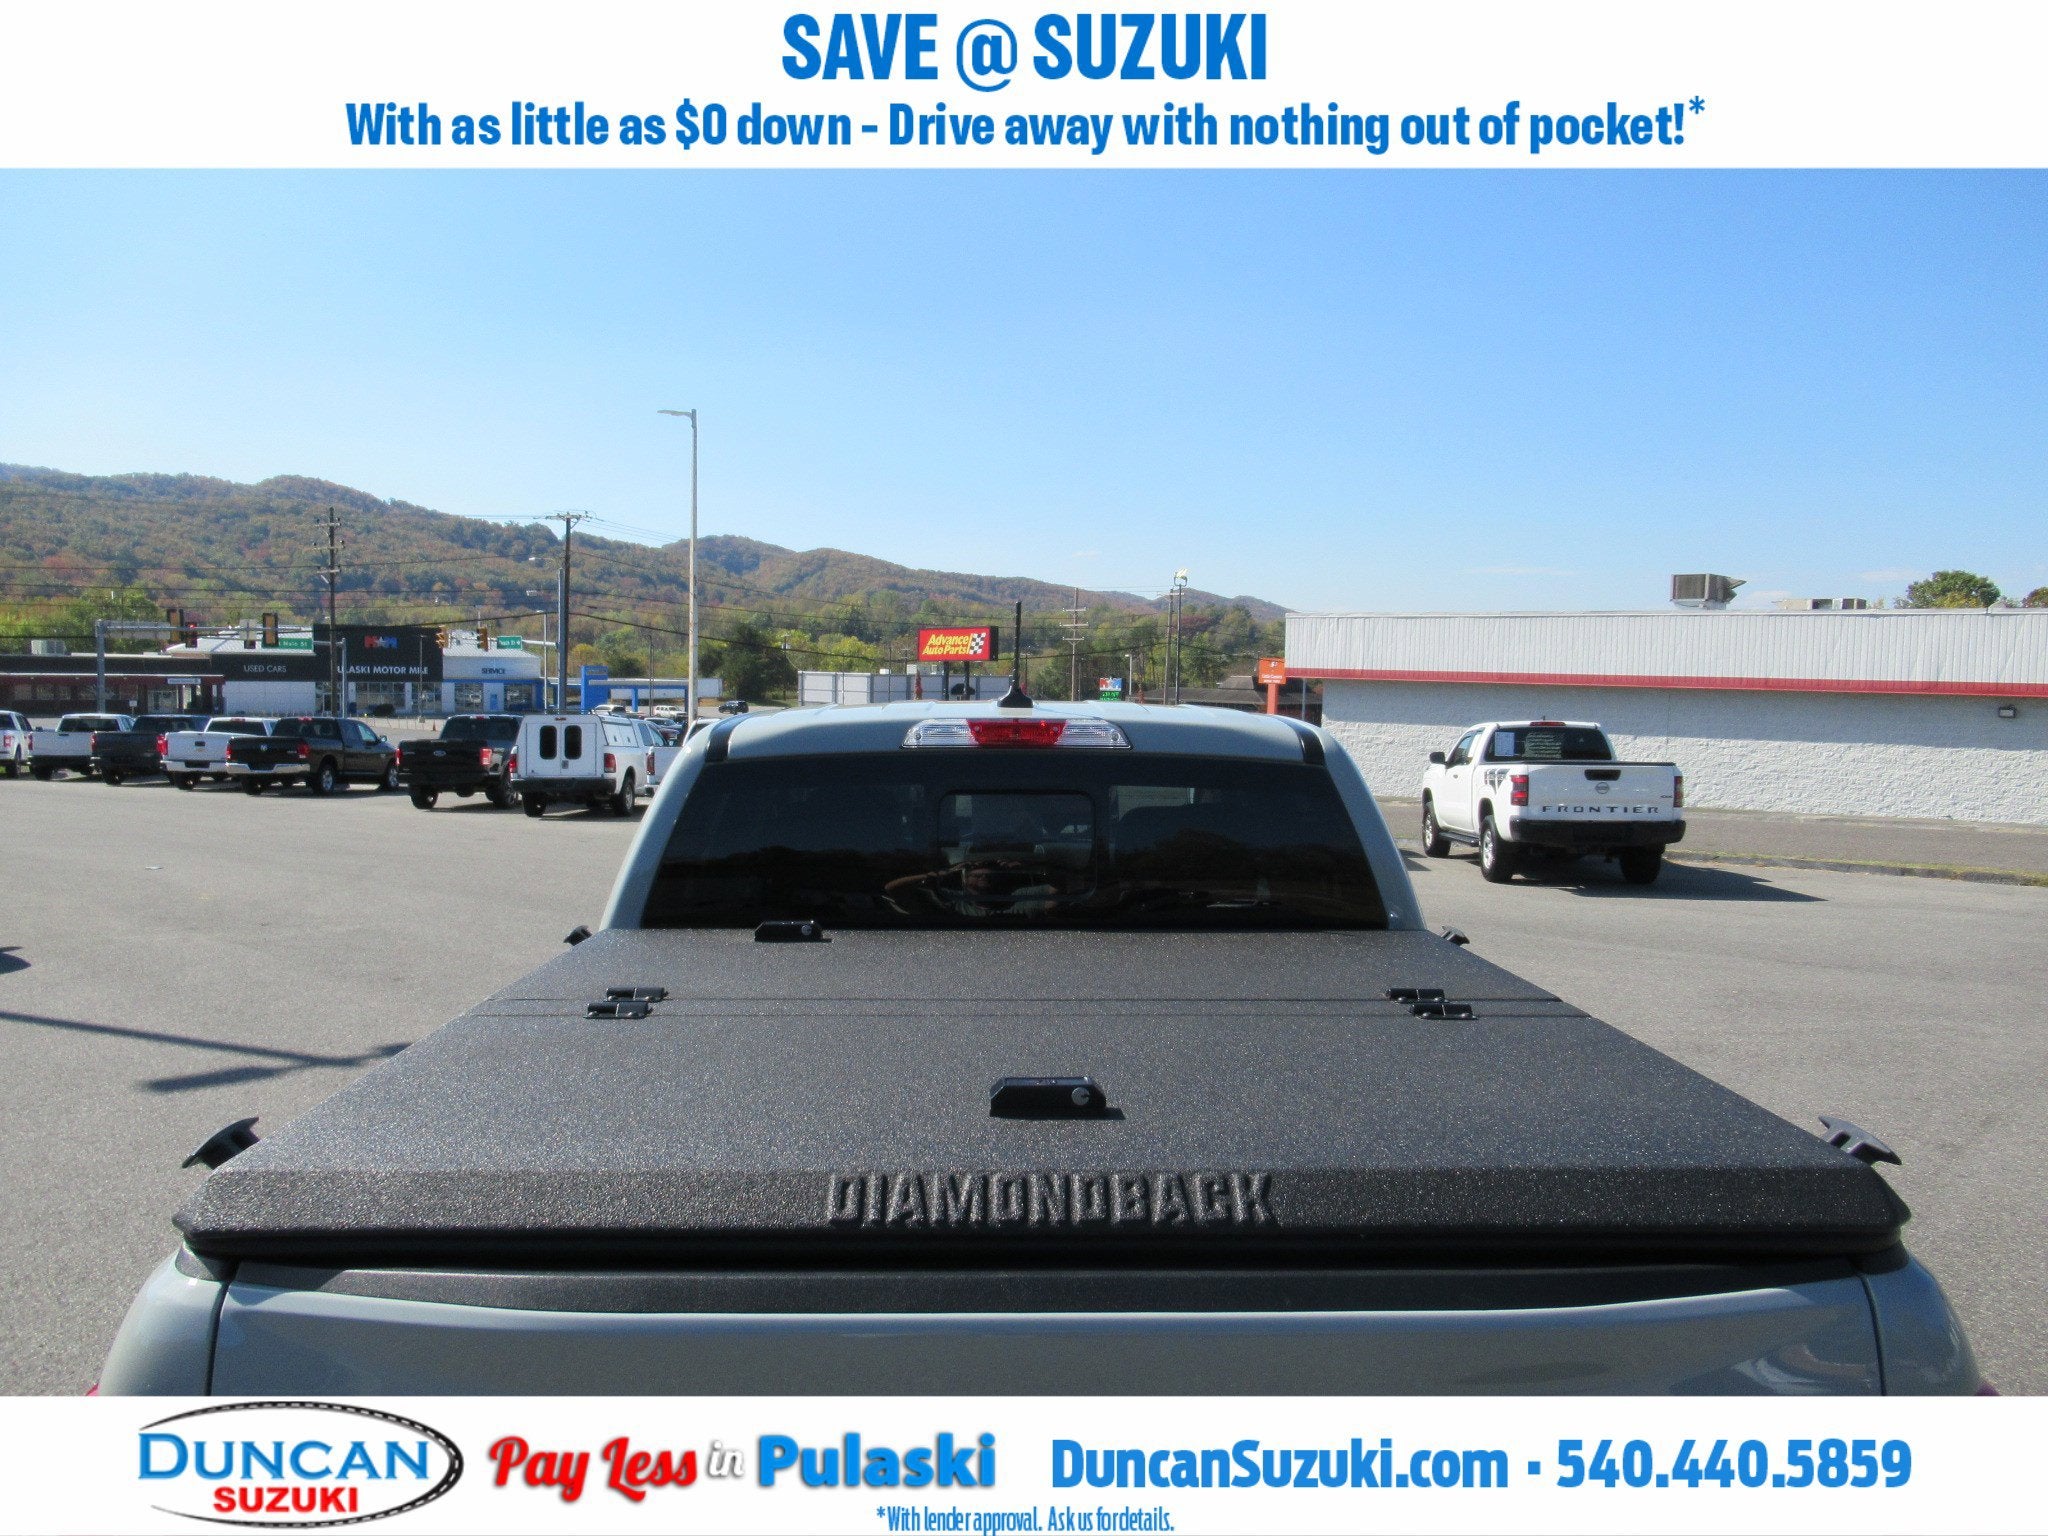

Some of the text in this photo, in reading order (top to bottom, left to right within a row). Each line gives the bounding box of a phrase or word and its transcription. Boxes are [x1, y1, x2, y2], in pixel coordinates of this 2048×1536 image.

[927, 634, 969, 646] Advance
[922, 645, 968, 655] Auto Parts
[243, 664, 287, 673] USED CARS
[336, 665, 370, 674] UASKI
[373, 665, 407, 674] MOTOR
[1541, 804, 1660, 815] FRONTIER
[825, 1172, 1278, 1226] DIAMONDBACK
